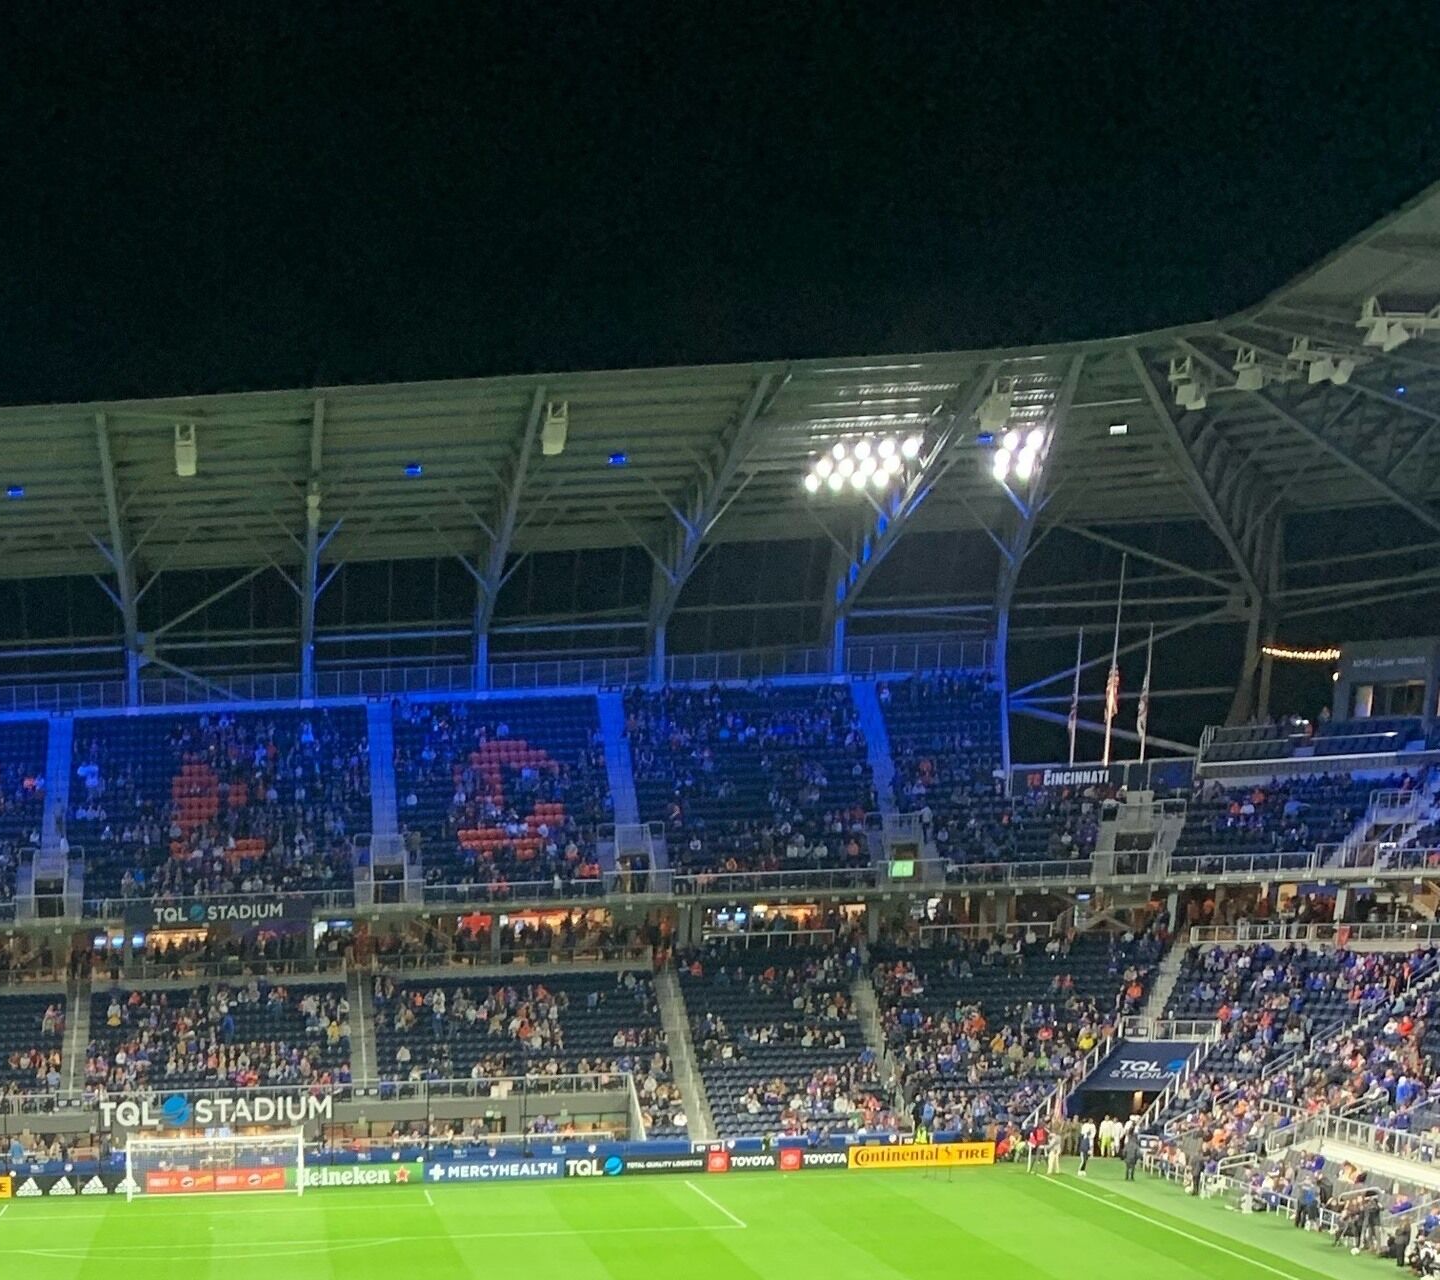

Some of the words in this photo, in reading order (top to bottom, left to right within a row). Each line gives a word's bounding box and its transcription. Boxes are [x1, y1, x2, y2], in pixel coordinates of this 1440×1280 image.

[1043, 769, 1110, 787] CINCINNATI
[153, 907, 188, 922] TQL
[207, 902, 284, 921] STADIUM
[1120, 1060, 1162, 1071] TQL
[100, 1102, 160, 1127] TQL
[195, 1095, 333, 1123] STADIUM
[730, 1156, 775, 1167] TOYOTA
[803, 1153, 847, 1164] TOYOTA
[854, 1148, 939, 1166] Continental
[956, 1149, 990, 1160] TIRE
[296, 1166, 391, 1187] Heineken
[448, 1162, 558, 1178] MERCYHEALTH
[566, 1159, 604, 1177] TQL
